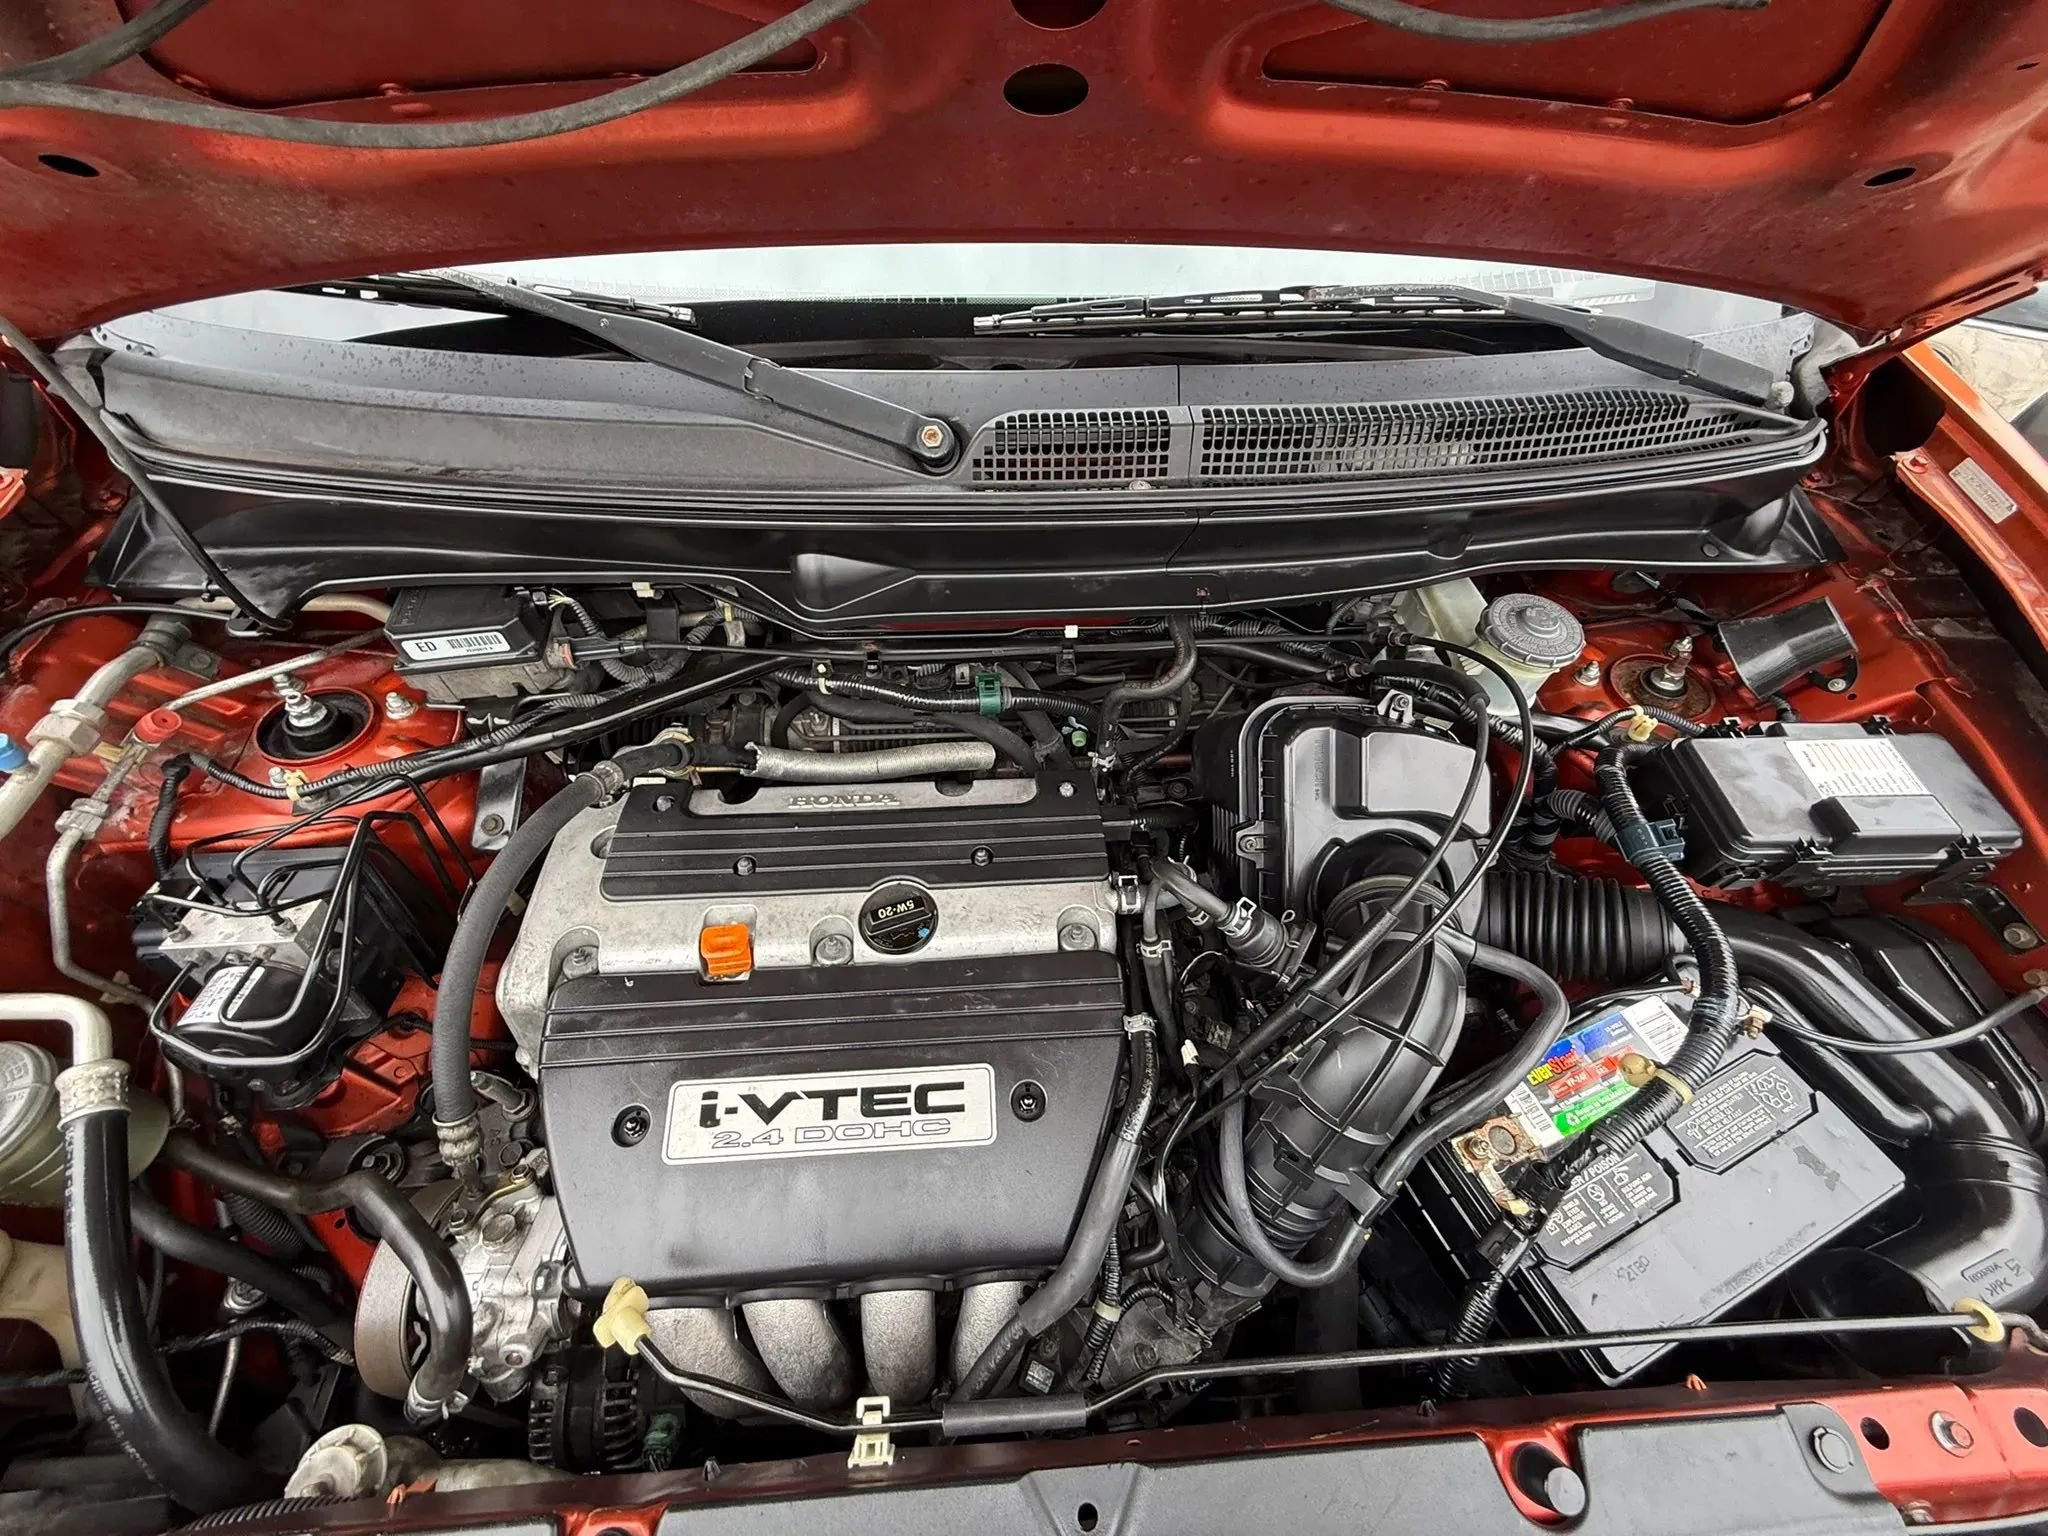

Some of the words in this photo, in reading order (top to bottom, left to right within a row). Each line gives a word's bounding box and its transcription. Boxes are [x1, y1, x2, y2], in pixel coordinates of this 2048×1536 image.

[414, 641, 438, 653] ED
[788, 793, 901, 809] HONDA
[699, 1080, 965, 1129] i-VTEC
[711, 1128, 784, 1149] 2.4
[795, 1118, 952, 1144] DOHC
